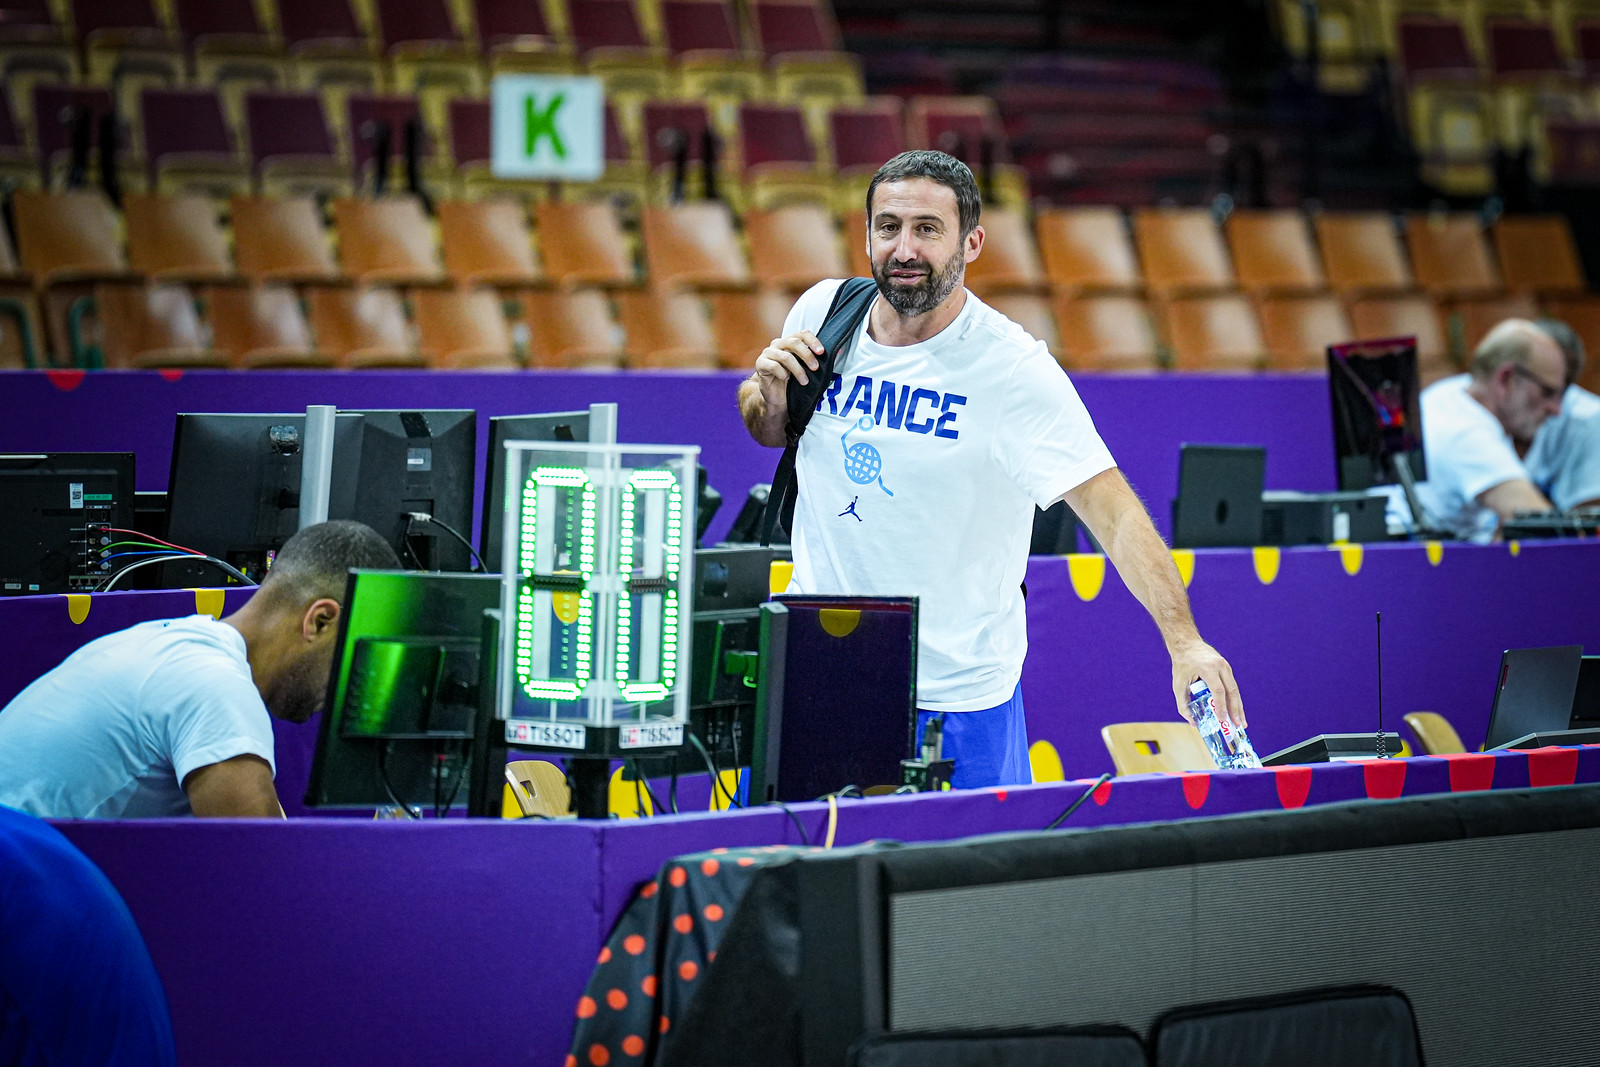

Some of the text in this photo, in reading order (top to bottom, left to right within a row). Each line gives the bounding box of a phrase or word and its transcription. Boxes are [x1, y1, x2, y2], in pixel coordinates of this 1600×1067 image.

[525, 93, 566, 158] K
[816, 372, 968, 440] RANCE
[529, 725, 582, 744] TISSOT
[640, 725, 683, 743] TISSOT
